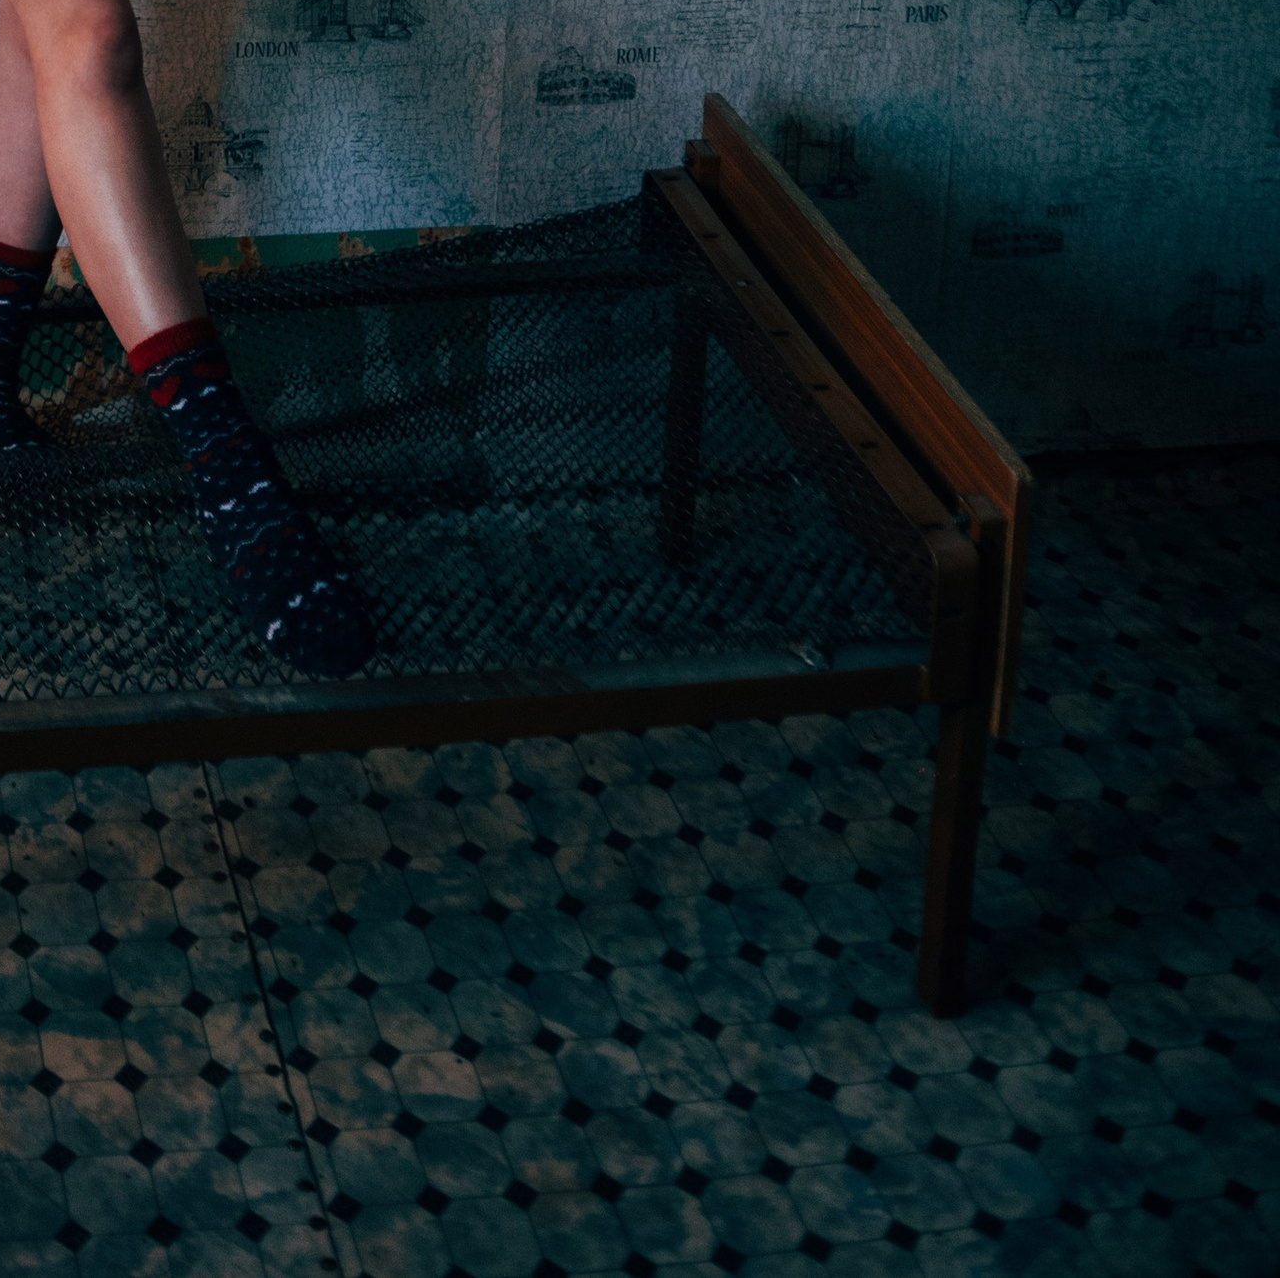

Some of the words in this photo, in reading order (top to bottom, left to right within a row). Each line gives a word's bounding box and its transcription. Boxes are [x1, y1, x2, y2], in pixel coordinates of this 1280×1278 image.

[905, 5, 950, 23] PARIS
[235, 41, 300, 59] LONDON
[615, 47, 660, 66] ROME
